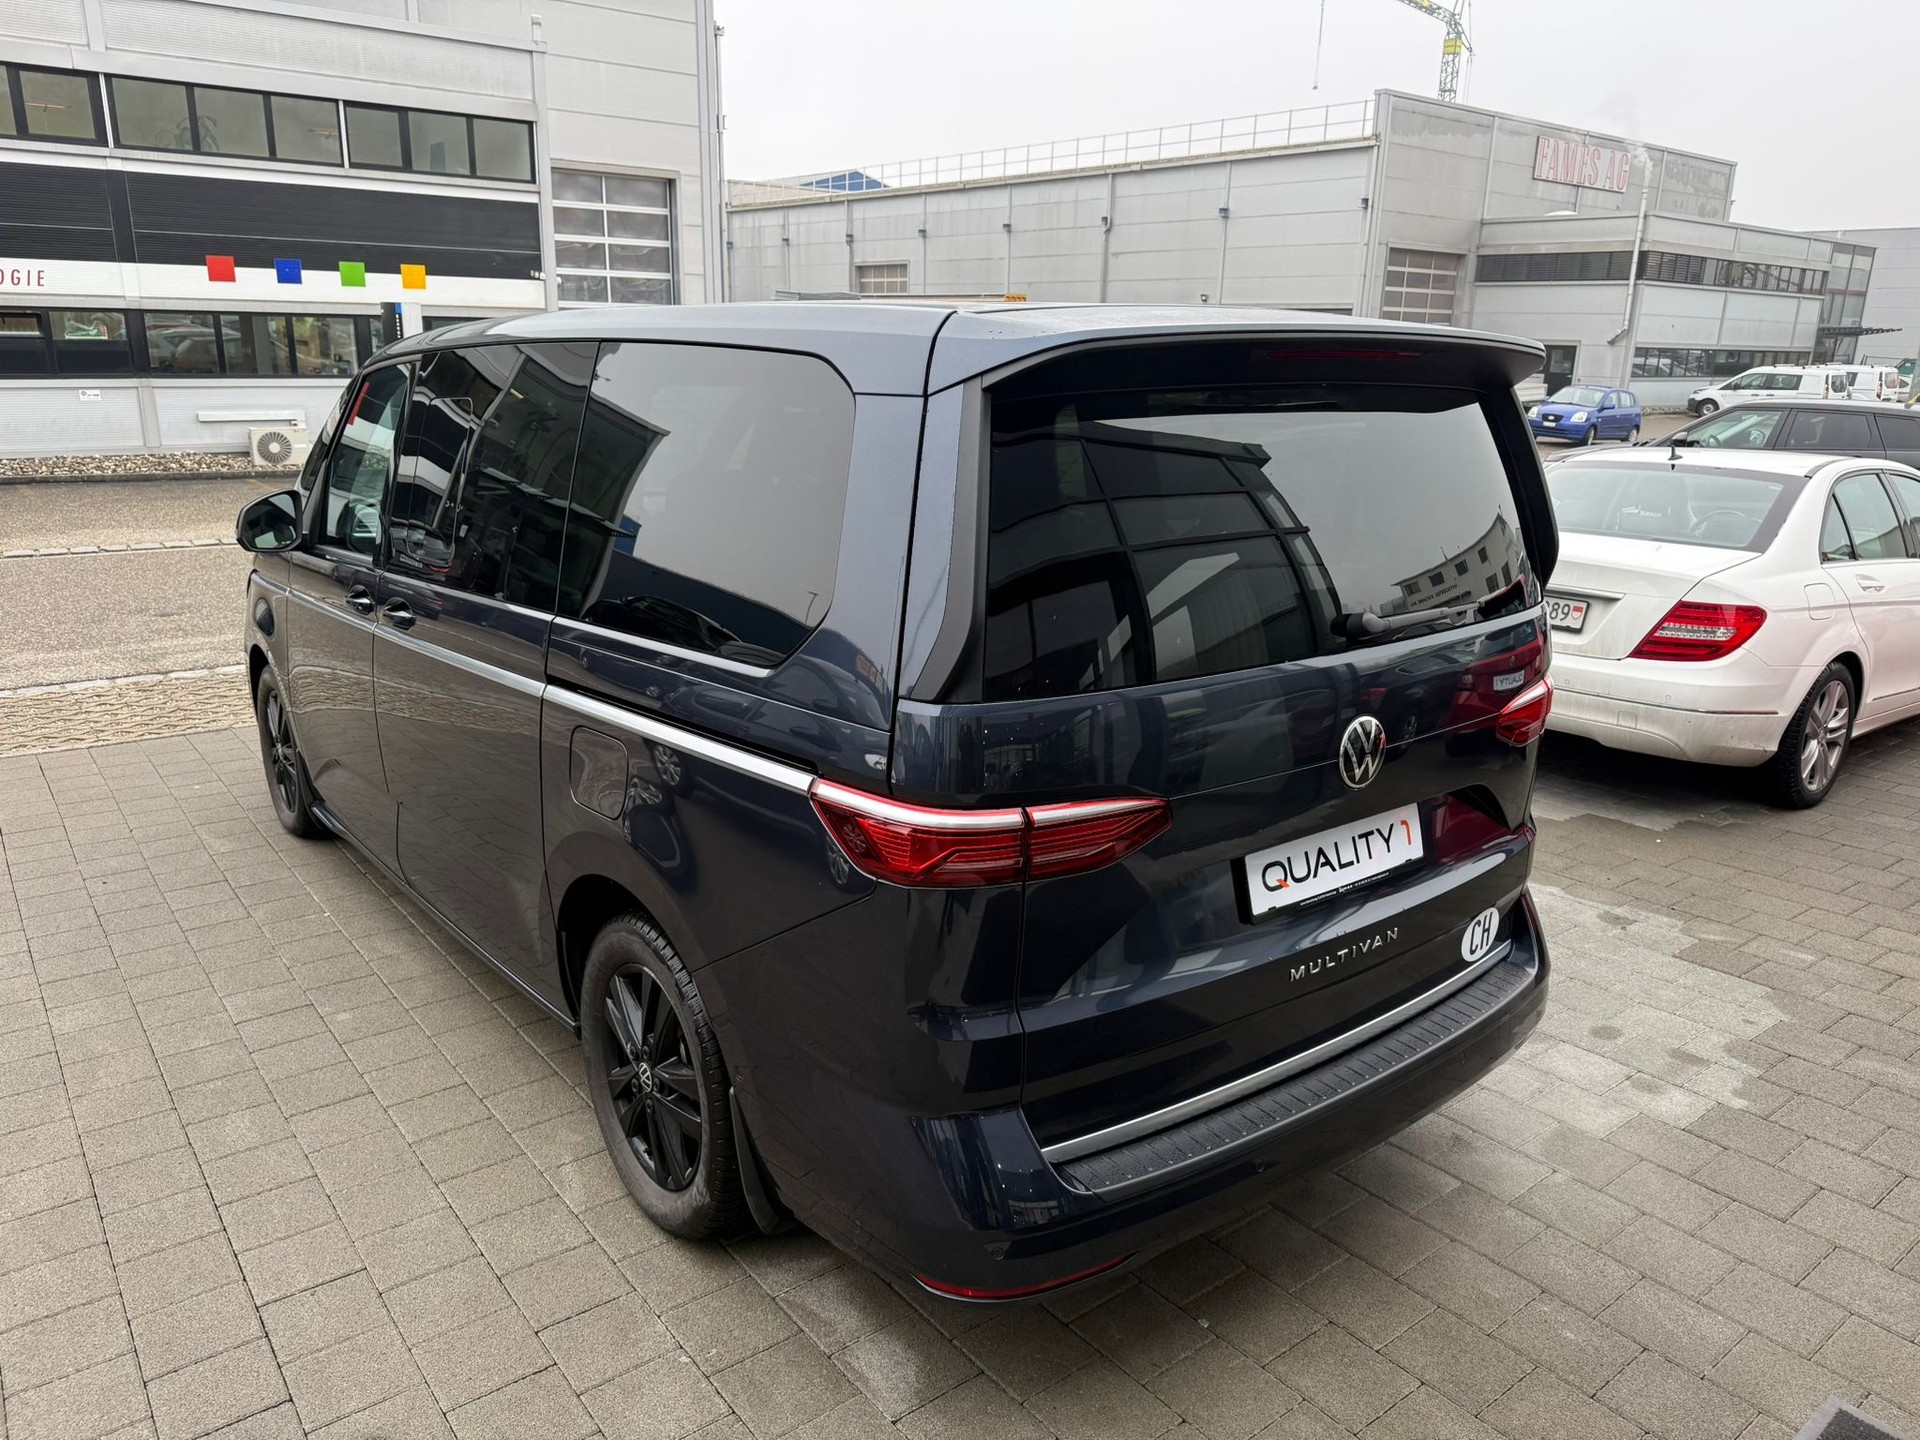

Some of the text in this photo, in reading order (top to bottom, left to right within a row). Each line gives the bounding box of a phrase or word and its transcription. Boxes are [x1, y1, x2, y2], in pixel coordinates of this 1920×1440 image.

[1602, 150, 1629, 191] AG
[1289, 927, 1398, 982] MULTIVAN
[1469, 911, 1494, 956] CH
